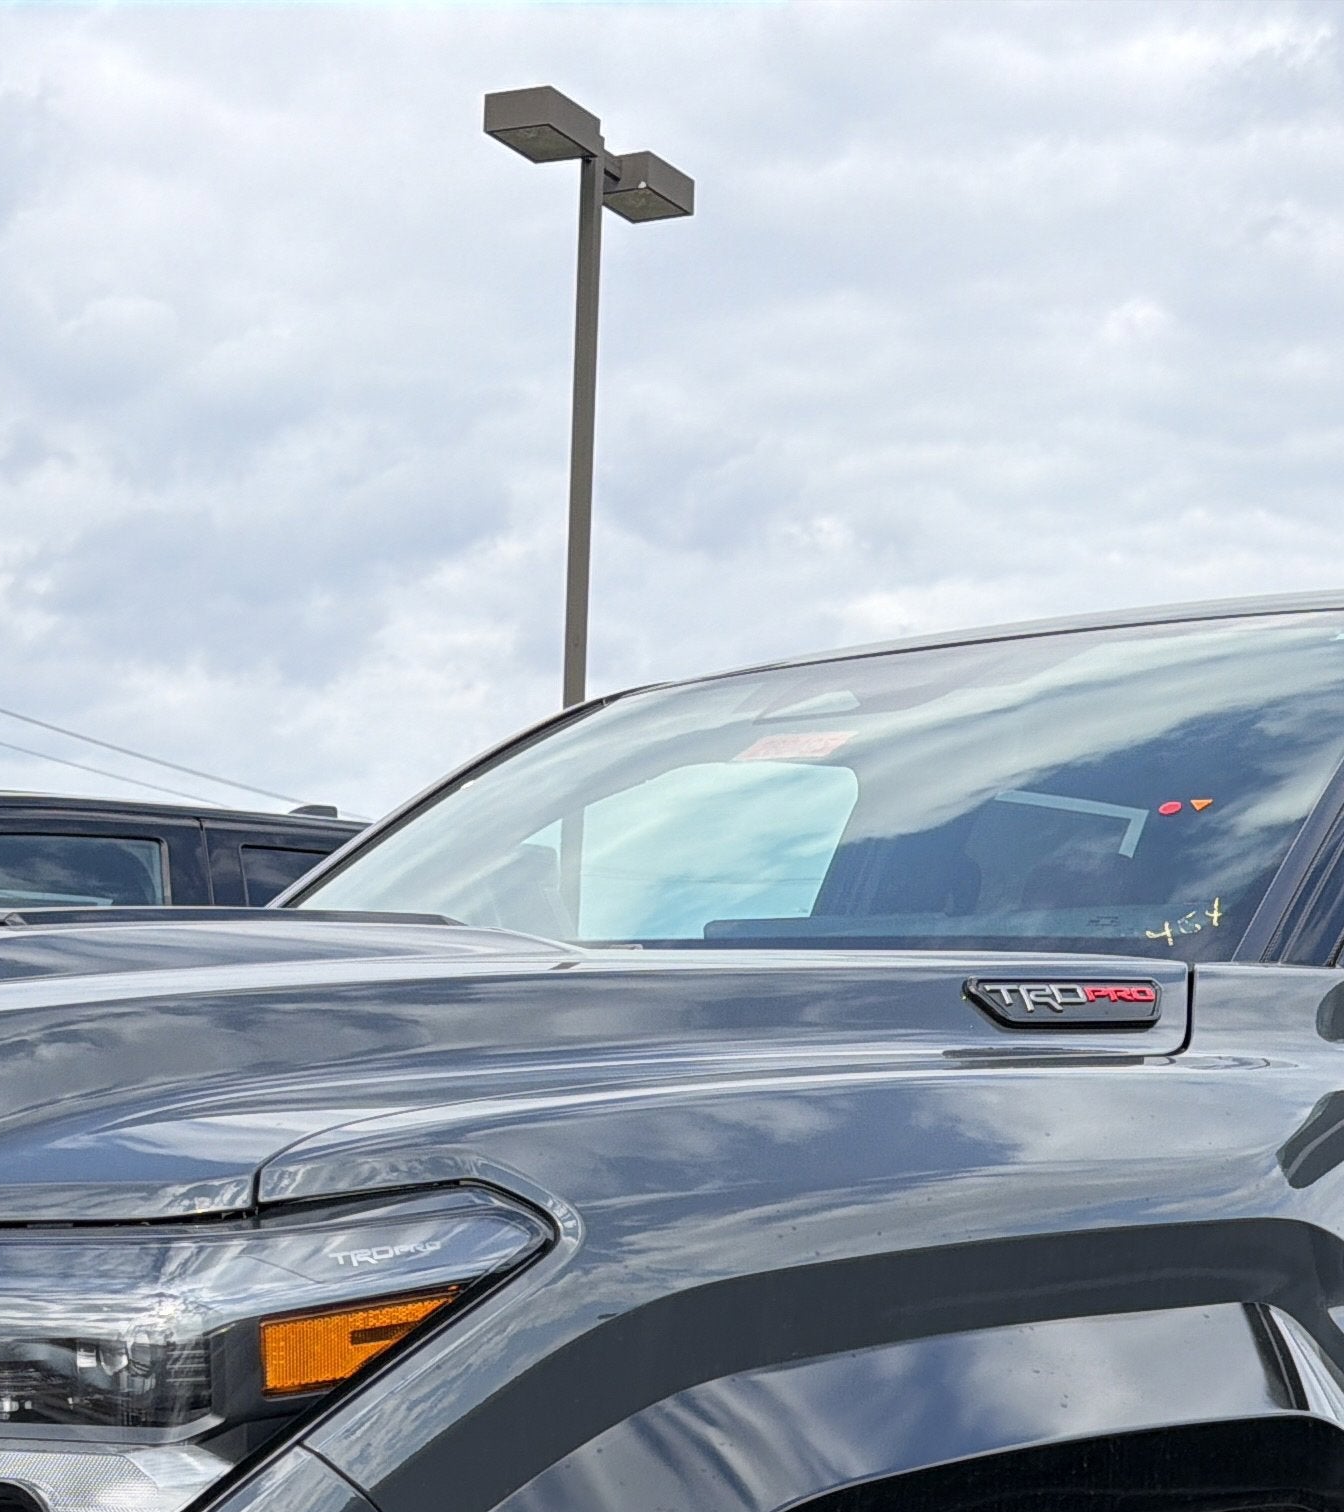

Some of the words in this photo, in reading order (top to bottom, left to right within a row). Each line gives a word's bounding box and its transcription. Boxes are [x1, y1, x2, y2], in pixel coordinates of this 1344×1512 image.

[984, 984, 1087, 1013] TRD
[1083, 986, 1156, 1003] PRO
[329, 1246, 394, 1266] TRD
[395, 1241, 441, 1256] PRO
